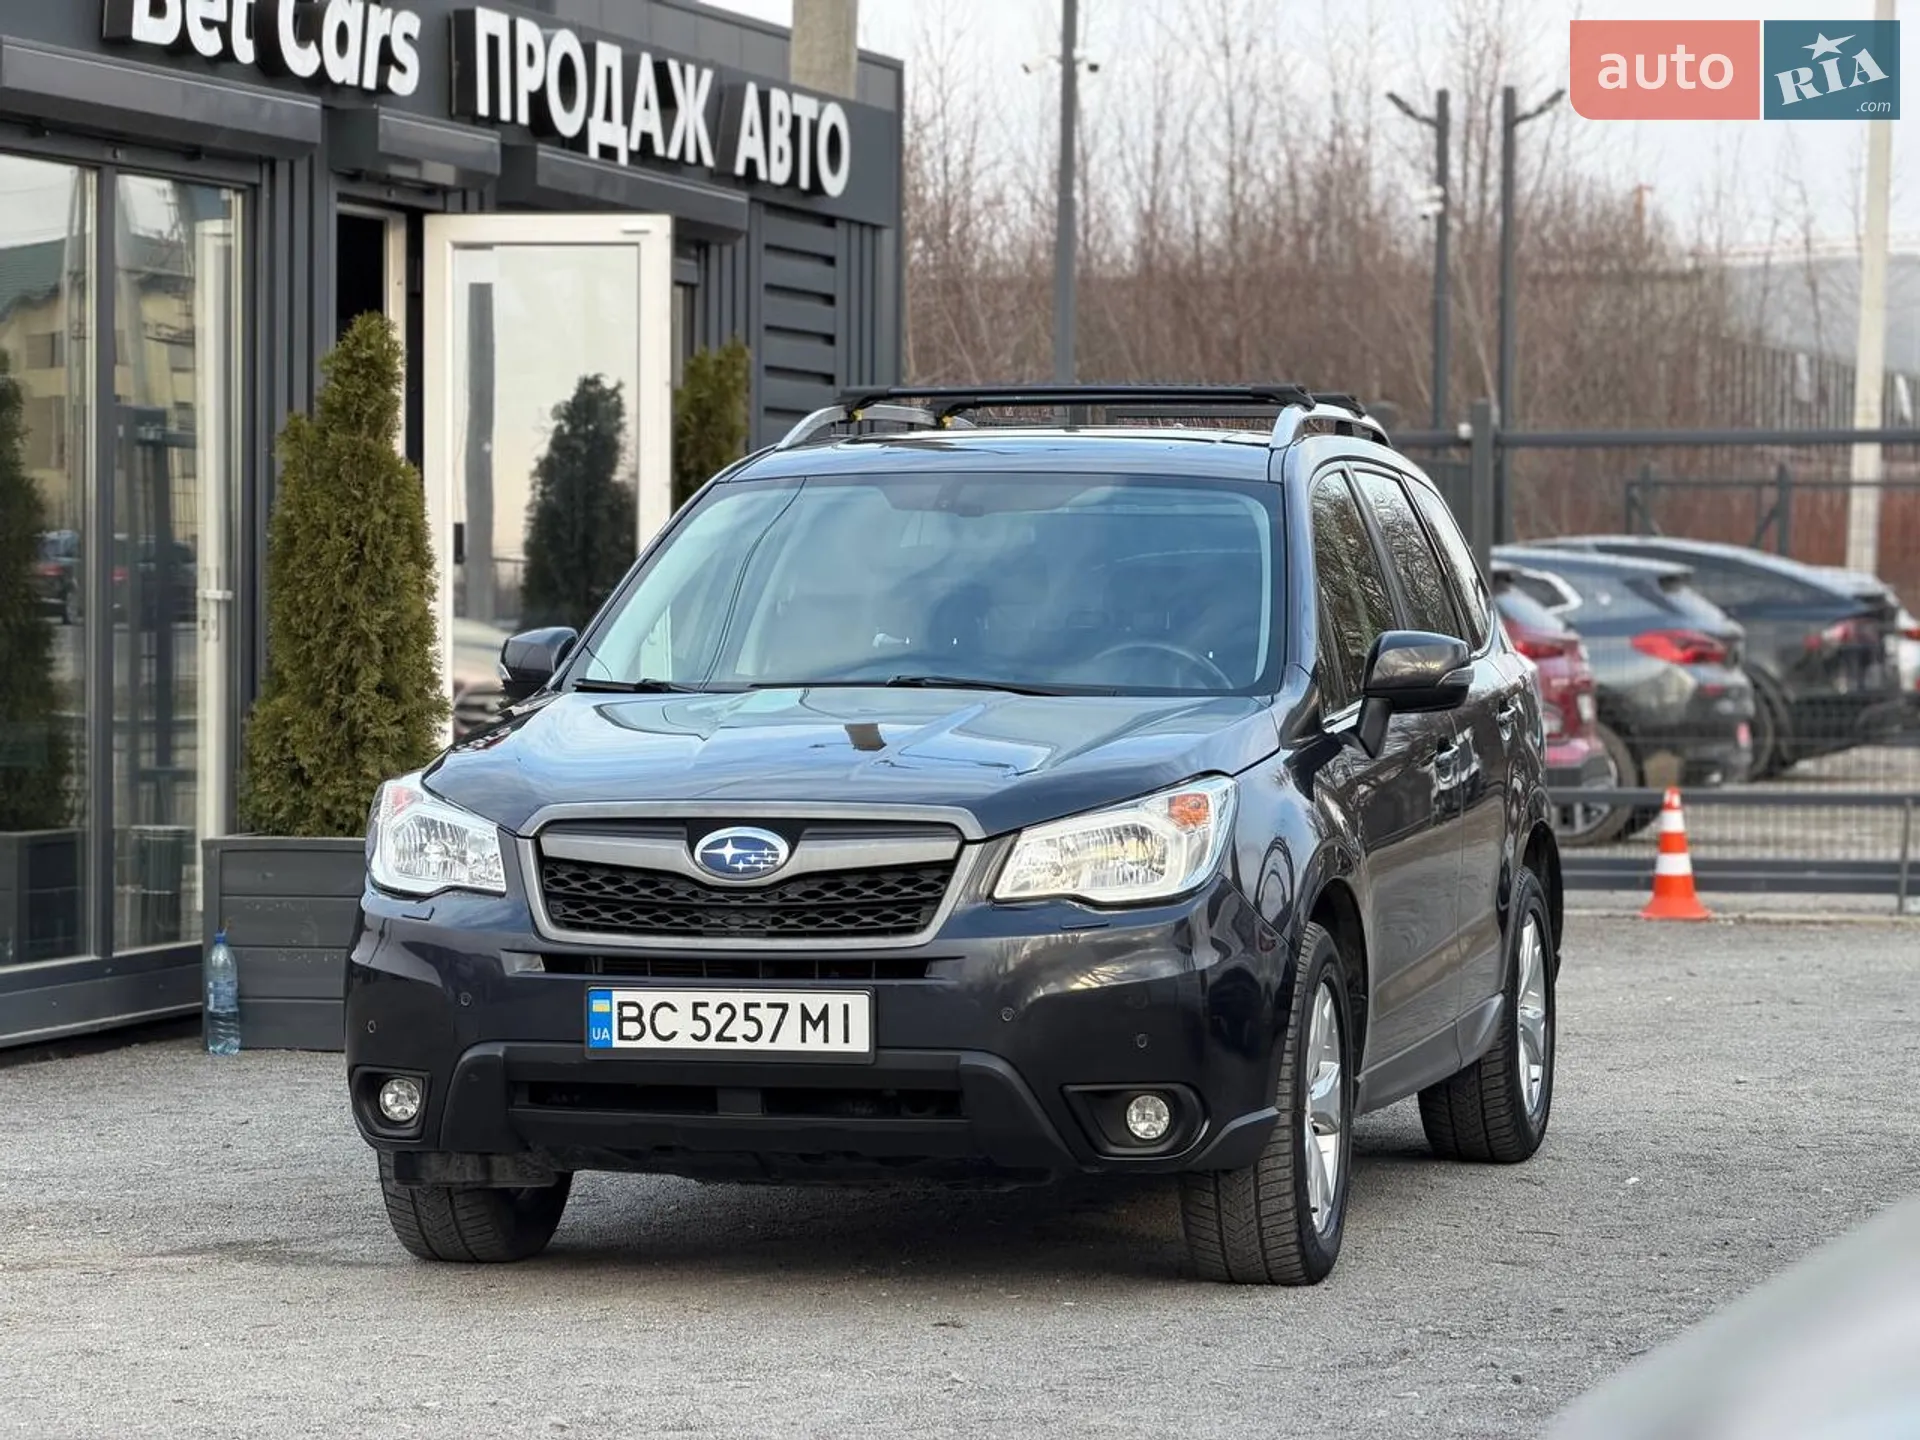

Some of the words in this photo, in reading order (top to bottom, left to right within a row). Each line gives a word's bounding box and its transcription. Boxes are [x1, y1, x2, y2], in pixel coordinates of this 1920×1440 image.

[277, 0, 421, 96] Cars
[475, 6, 715, 166] ПРОДАЖ
[734, 81, 851, 198] АВТО
[592, 1027, 611, 1041] UA
[617, 1000, 679, 1042] BC
[689, 1002, 790, 1043] 5257
[800, 1002, 850, 1044] MI
